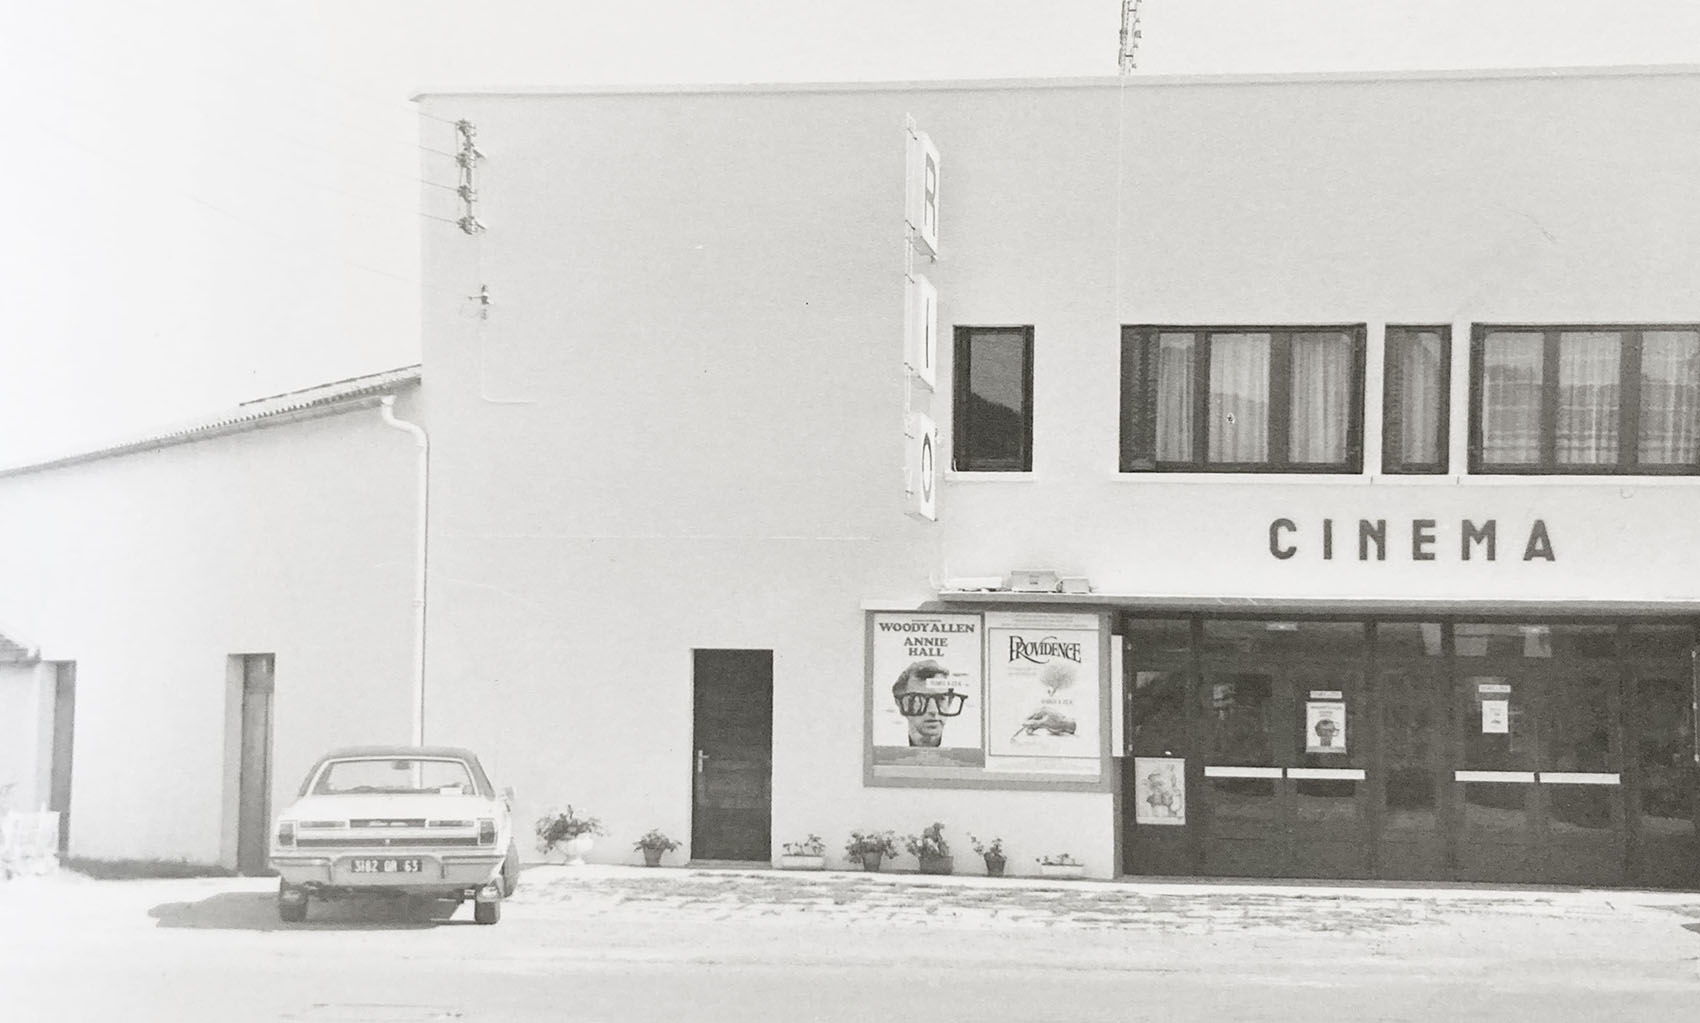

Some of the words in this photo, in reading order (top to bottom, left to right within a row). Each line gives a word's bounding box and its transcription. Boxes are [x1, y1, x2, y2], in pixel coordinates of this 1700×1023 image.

[923, 151, 936, 503] RIO
[1269, 518, 1556, 561] CINEMA
[879, 622, 929, 633] WOODY
[930, 623, 975, 633] ALLEN
[904, 637, 948, 647] ANNIE
[908, 647, 945, 657] HALL
